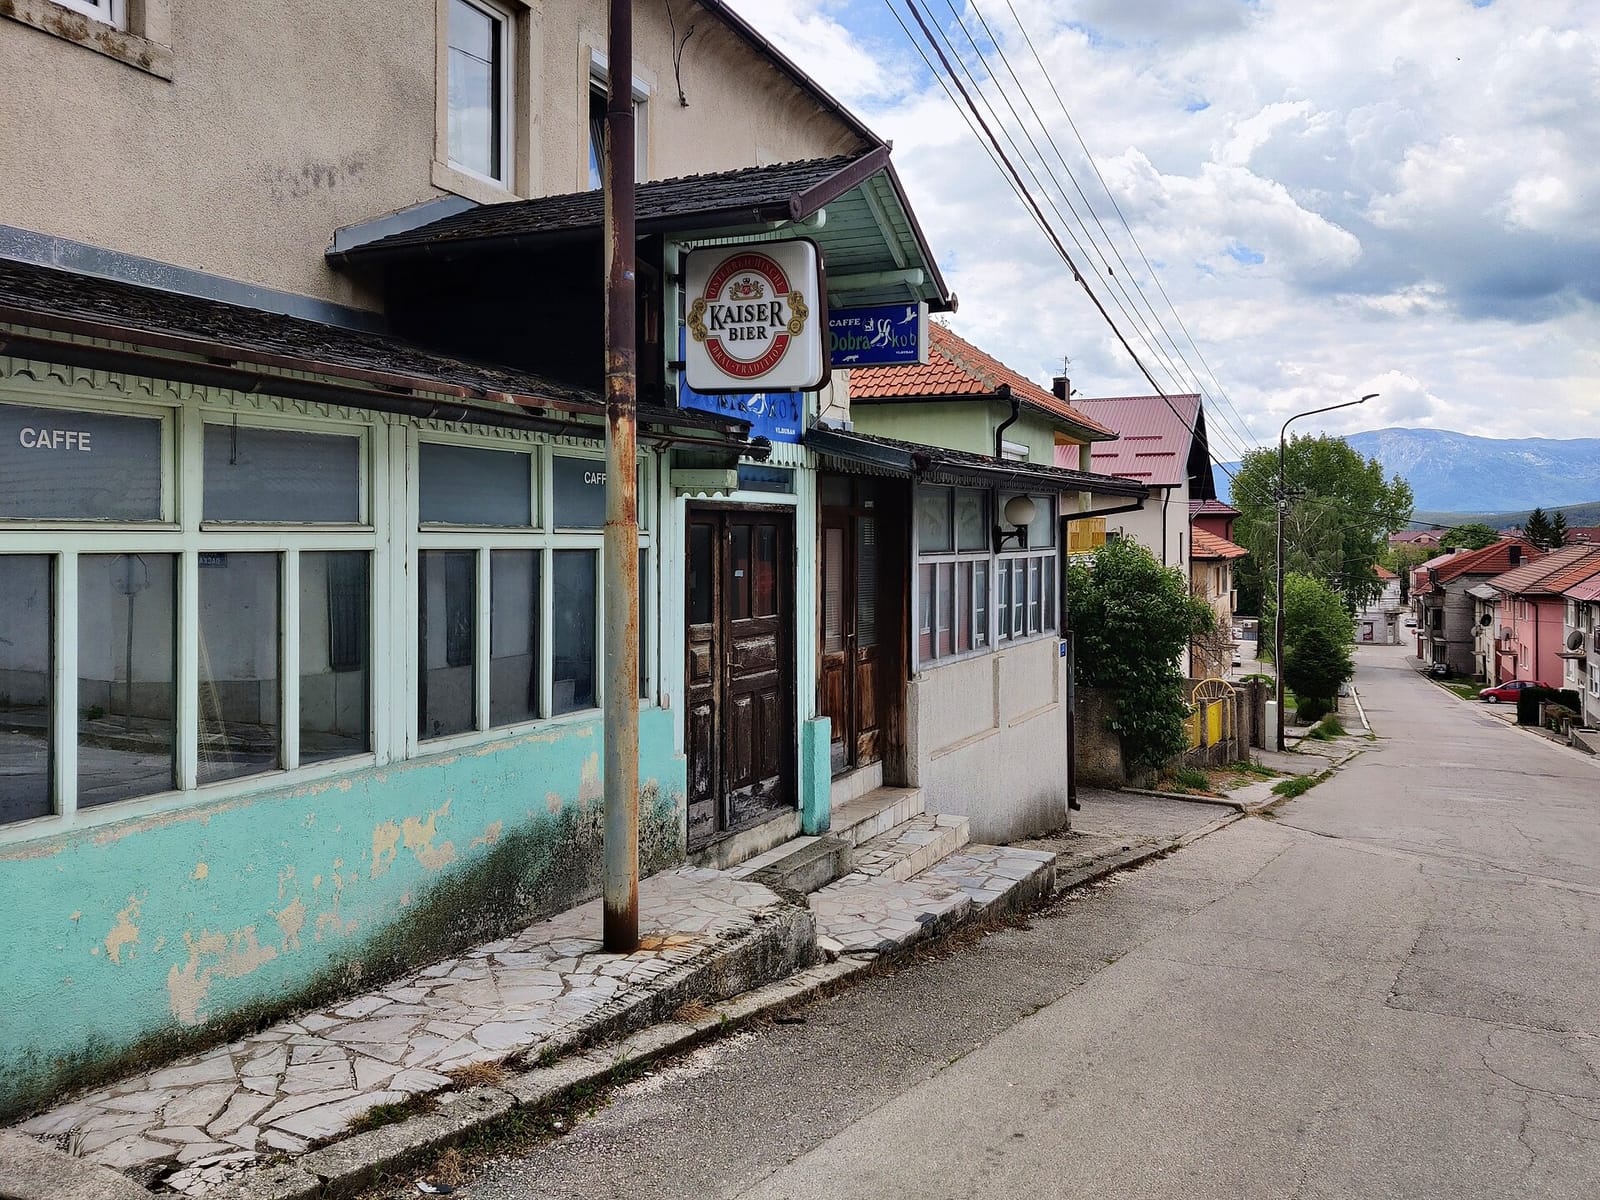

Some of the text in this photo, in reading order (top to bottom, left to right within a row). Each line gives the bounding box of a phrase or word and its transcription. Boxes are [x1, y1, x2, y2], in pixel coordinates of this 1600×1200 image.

[710, 301, 786, 330] KAISER
[829, 318, 861, 328] CAFFE
[729, 325, 768, 341] BIER
[829, 330, 871, 352] Dobra
[20, 427, 91, 451] CAFFE
[584, 471, 607, 485] CAFF
